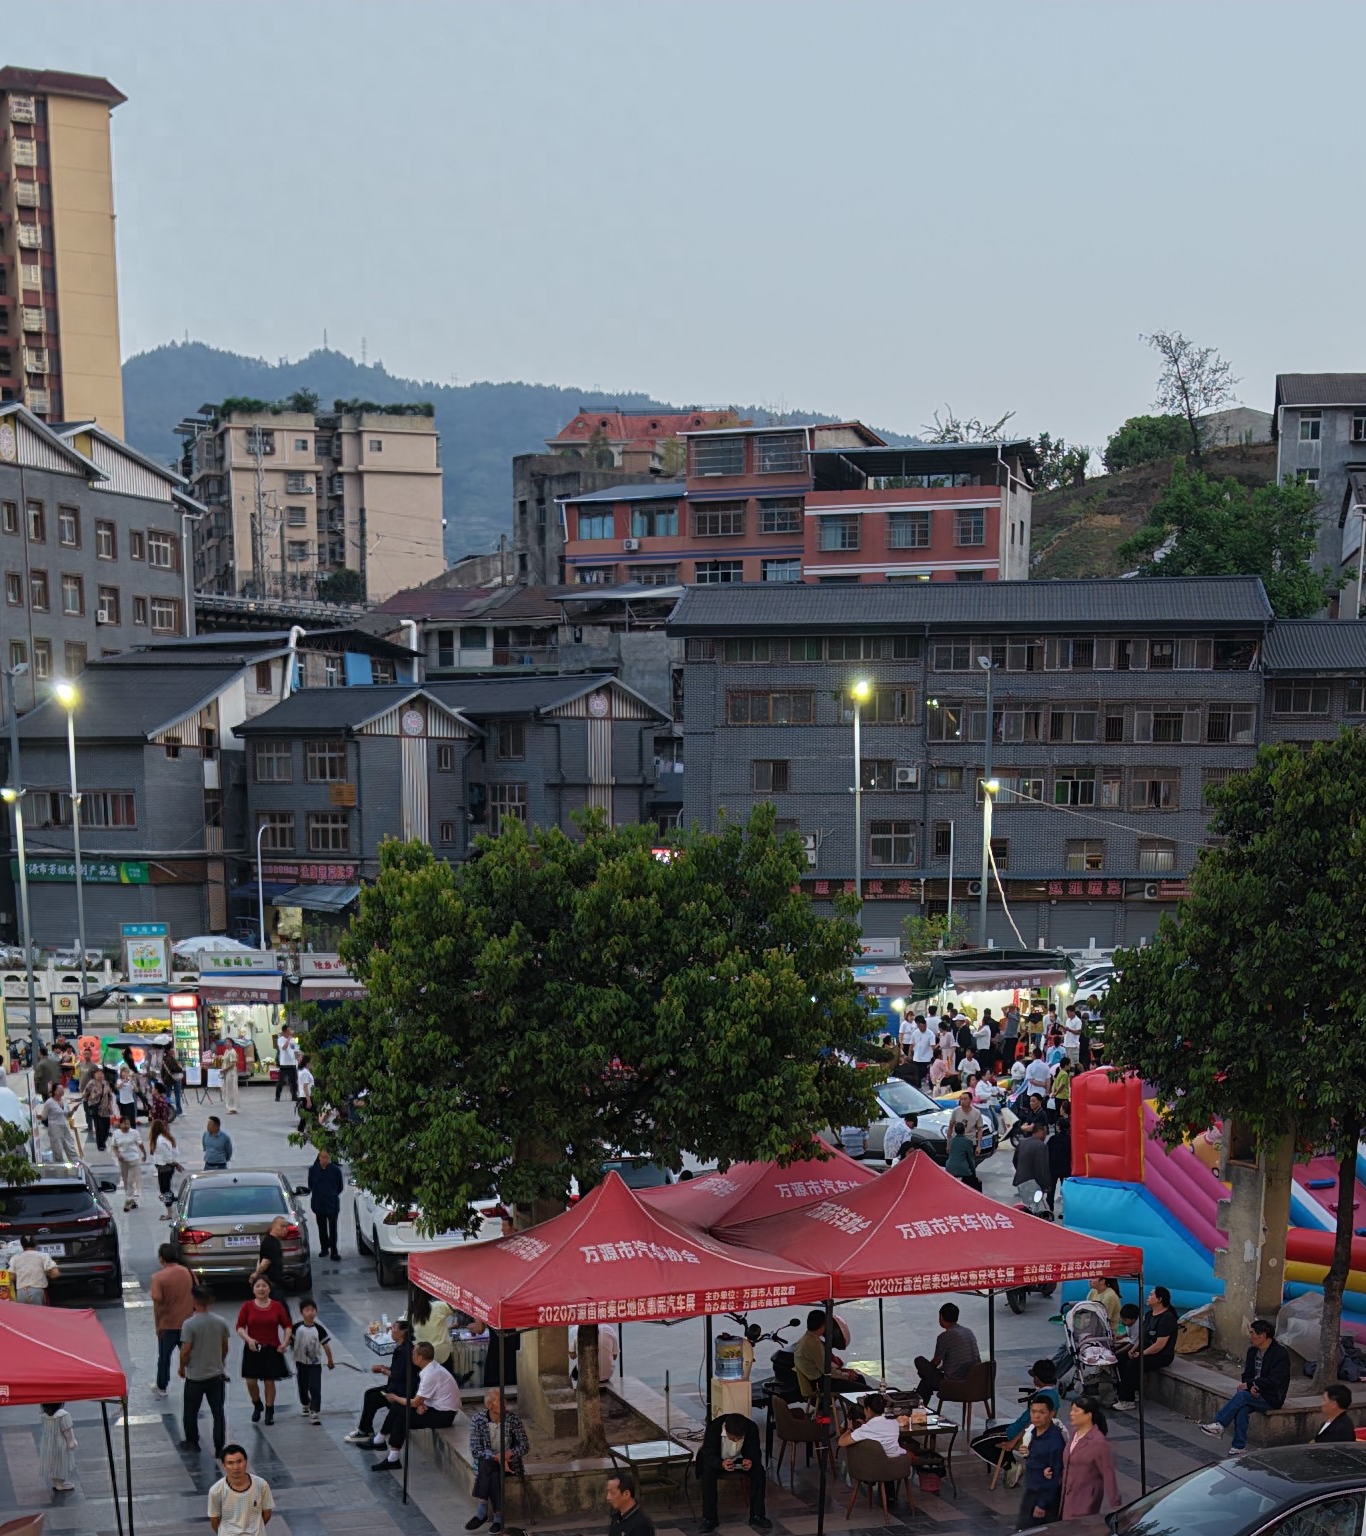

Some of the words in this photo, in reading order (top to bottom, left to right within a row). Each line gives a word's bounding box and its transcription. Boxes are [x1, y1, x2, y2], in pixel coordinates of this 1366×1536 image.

[895, 1212, 1015, 1240] 万源市汽车协会
[579, 1240, 701, 1264] 万源市汽车协会
